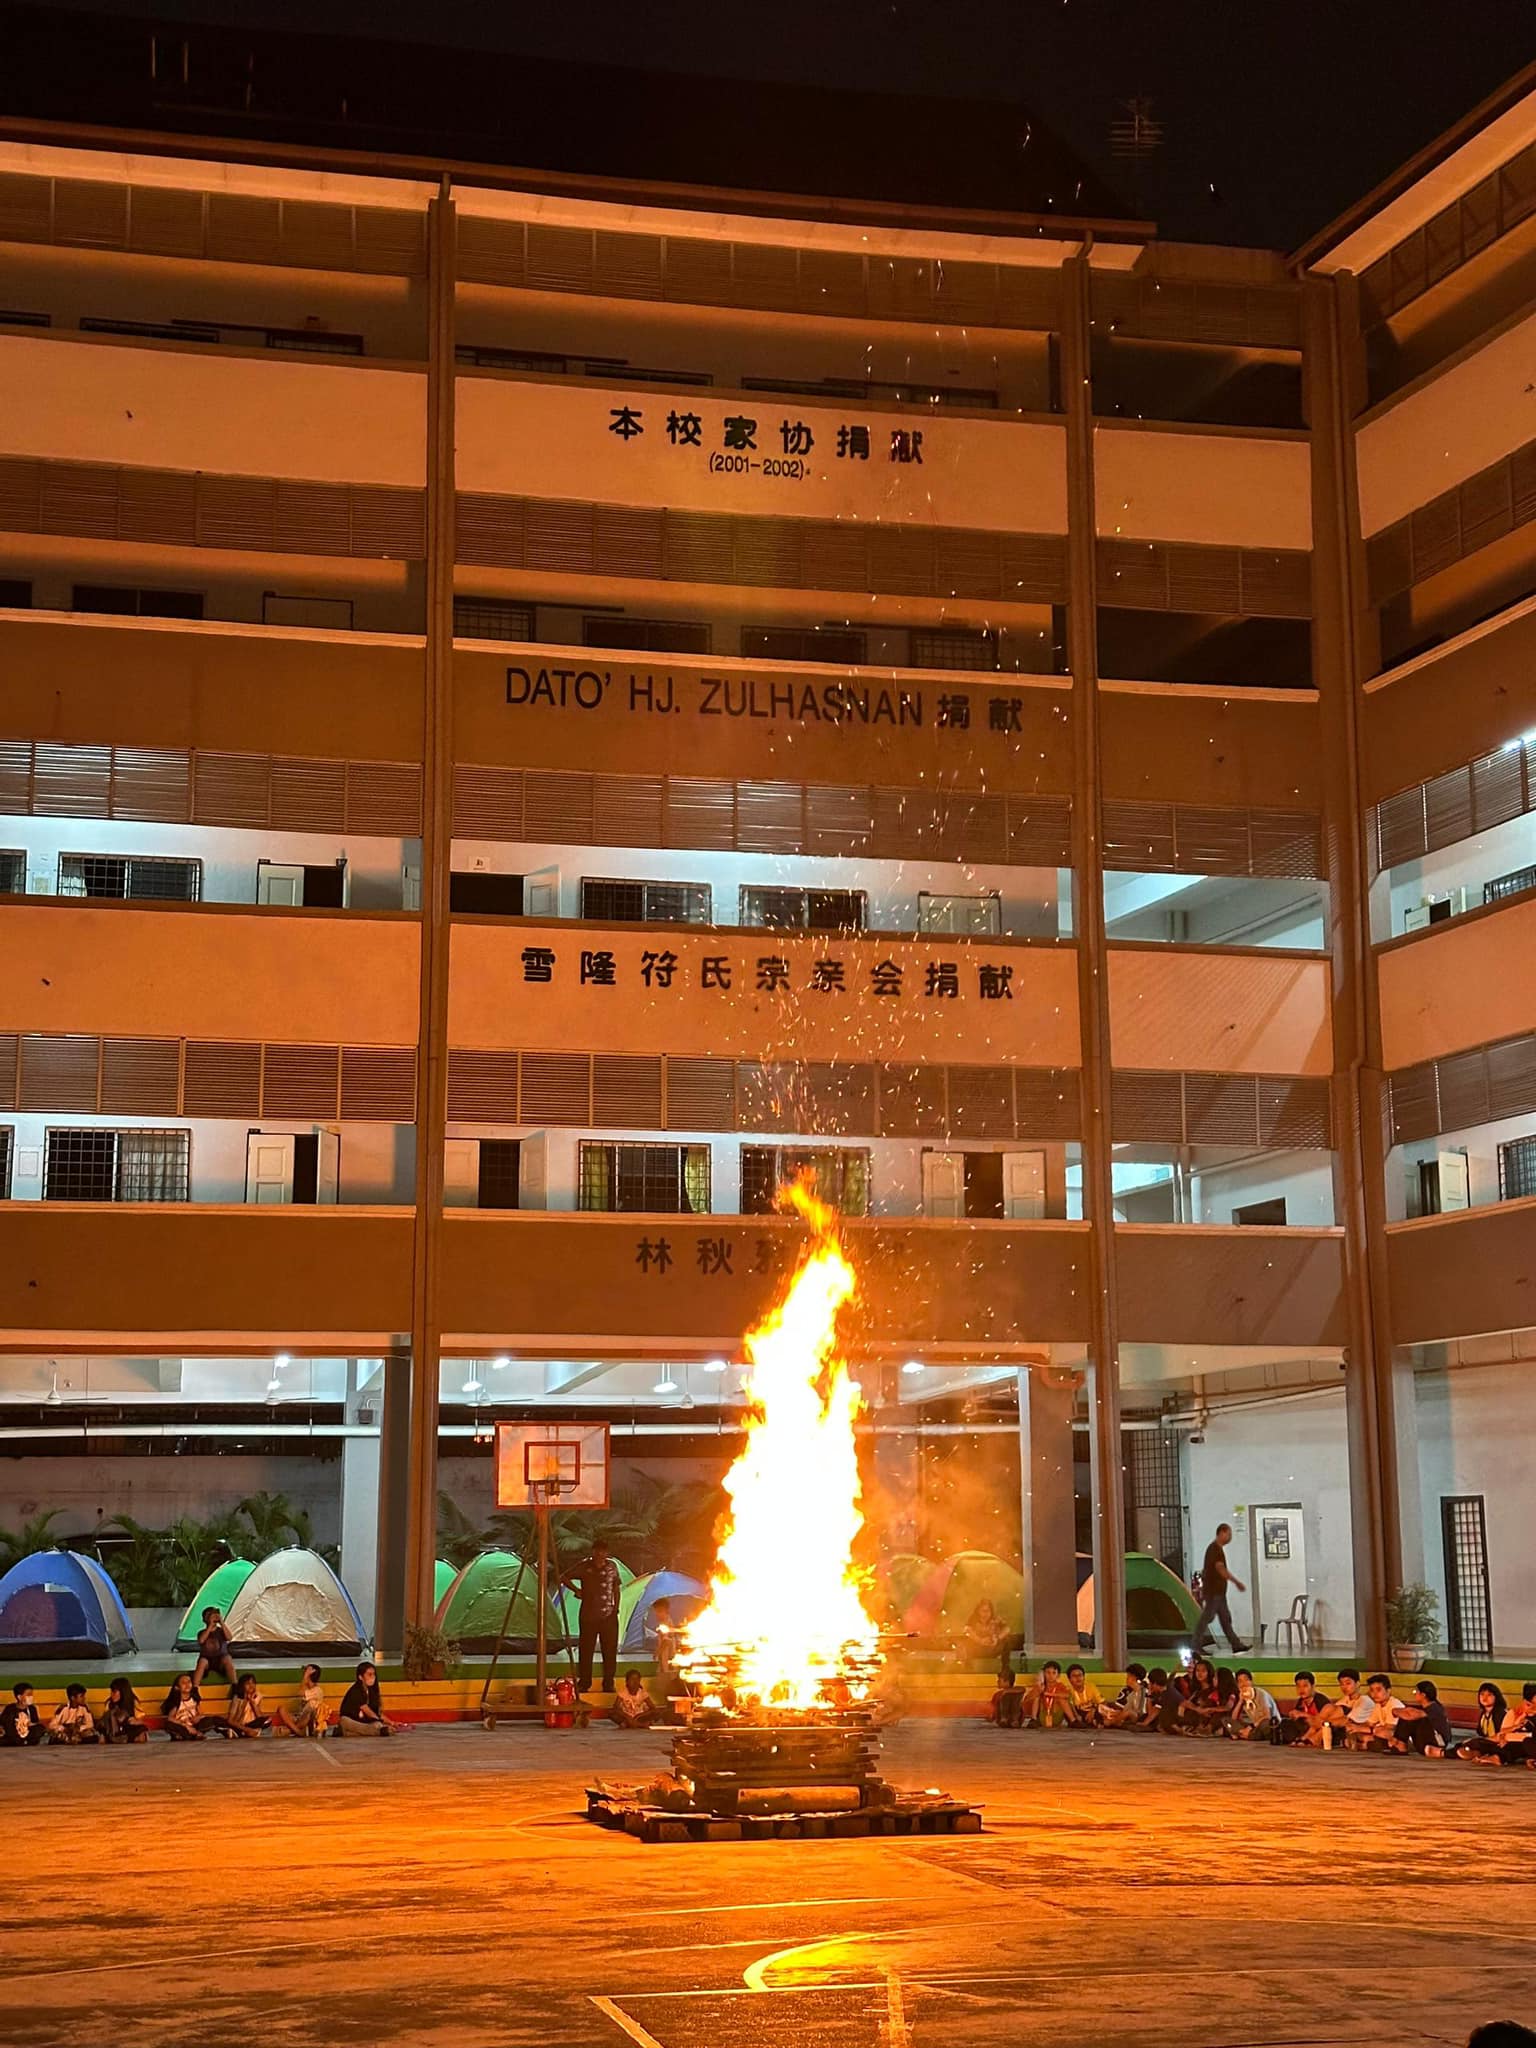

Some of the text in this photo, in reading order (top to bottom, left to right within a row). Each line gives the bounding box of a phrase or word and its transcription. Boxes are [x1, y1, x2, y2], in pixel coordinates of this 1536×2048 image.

[608, 405, 924, 464] 本校家协捐献
[708, 451, 805, 481] (2001-2002)
[505, 666, 1023, 732] DATO' HJ. ZULHASNAN 捐献
[520, 946, 1014, 1000] 雪隆符氏宗亲会捐献
